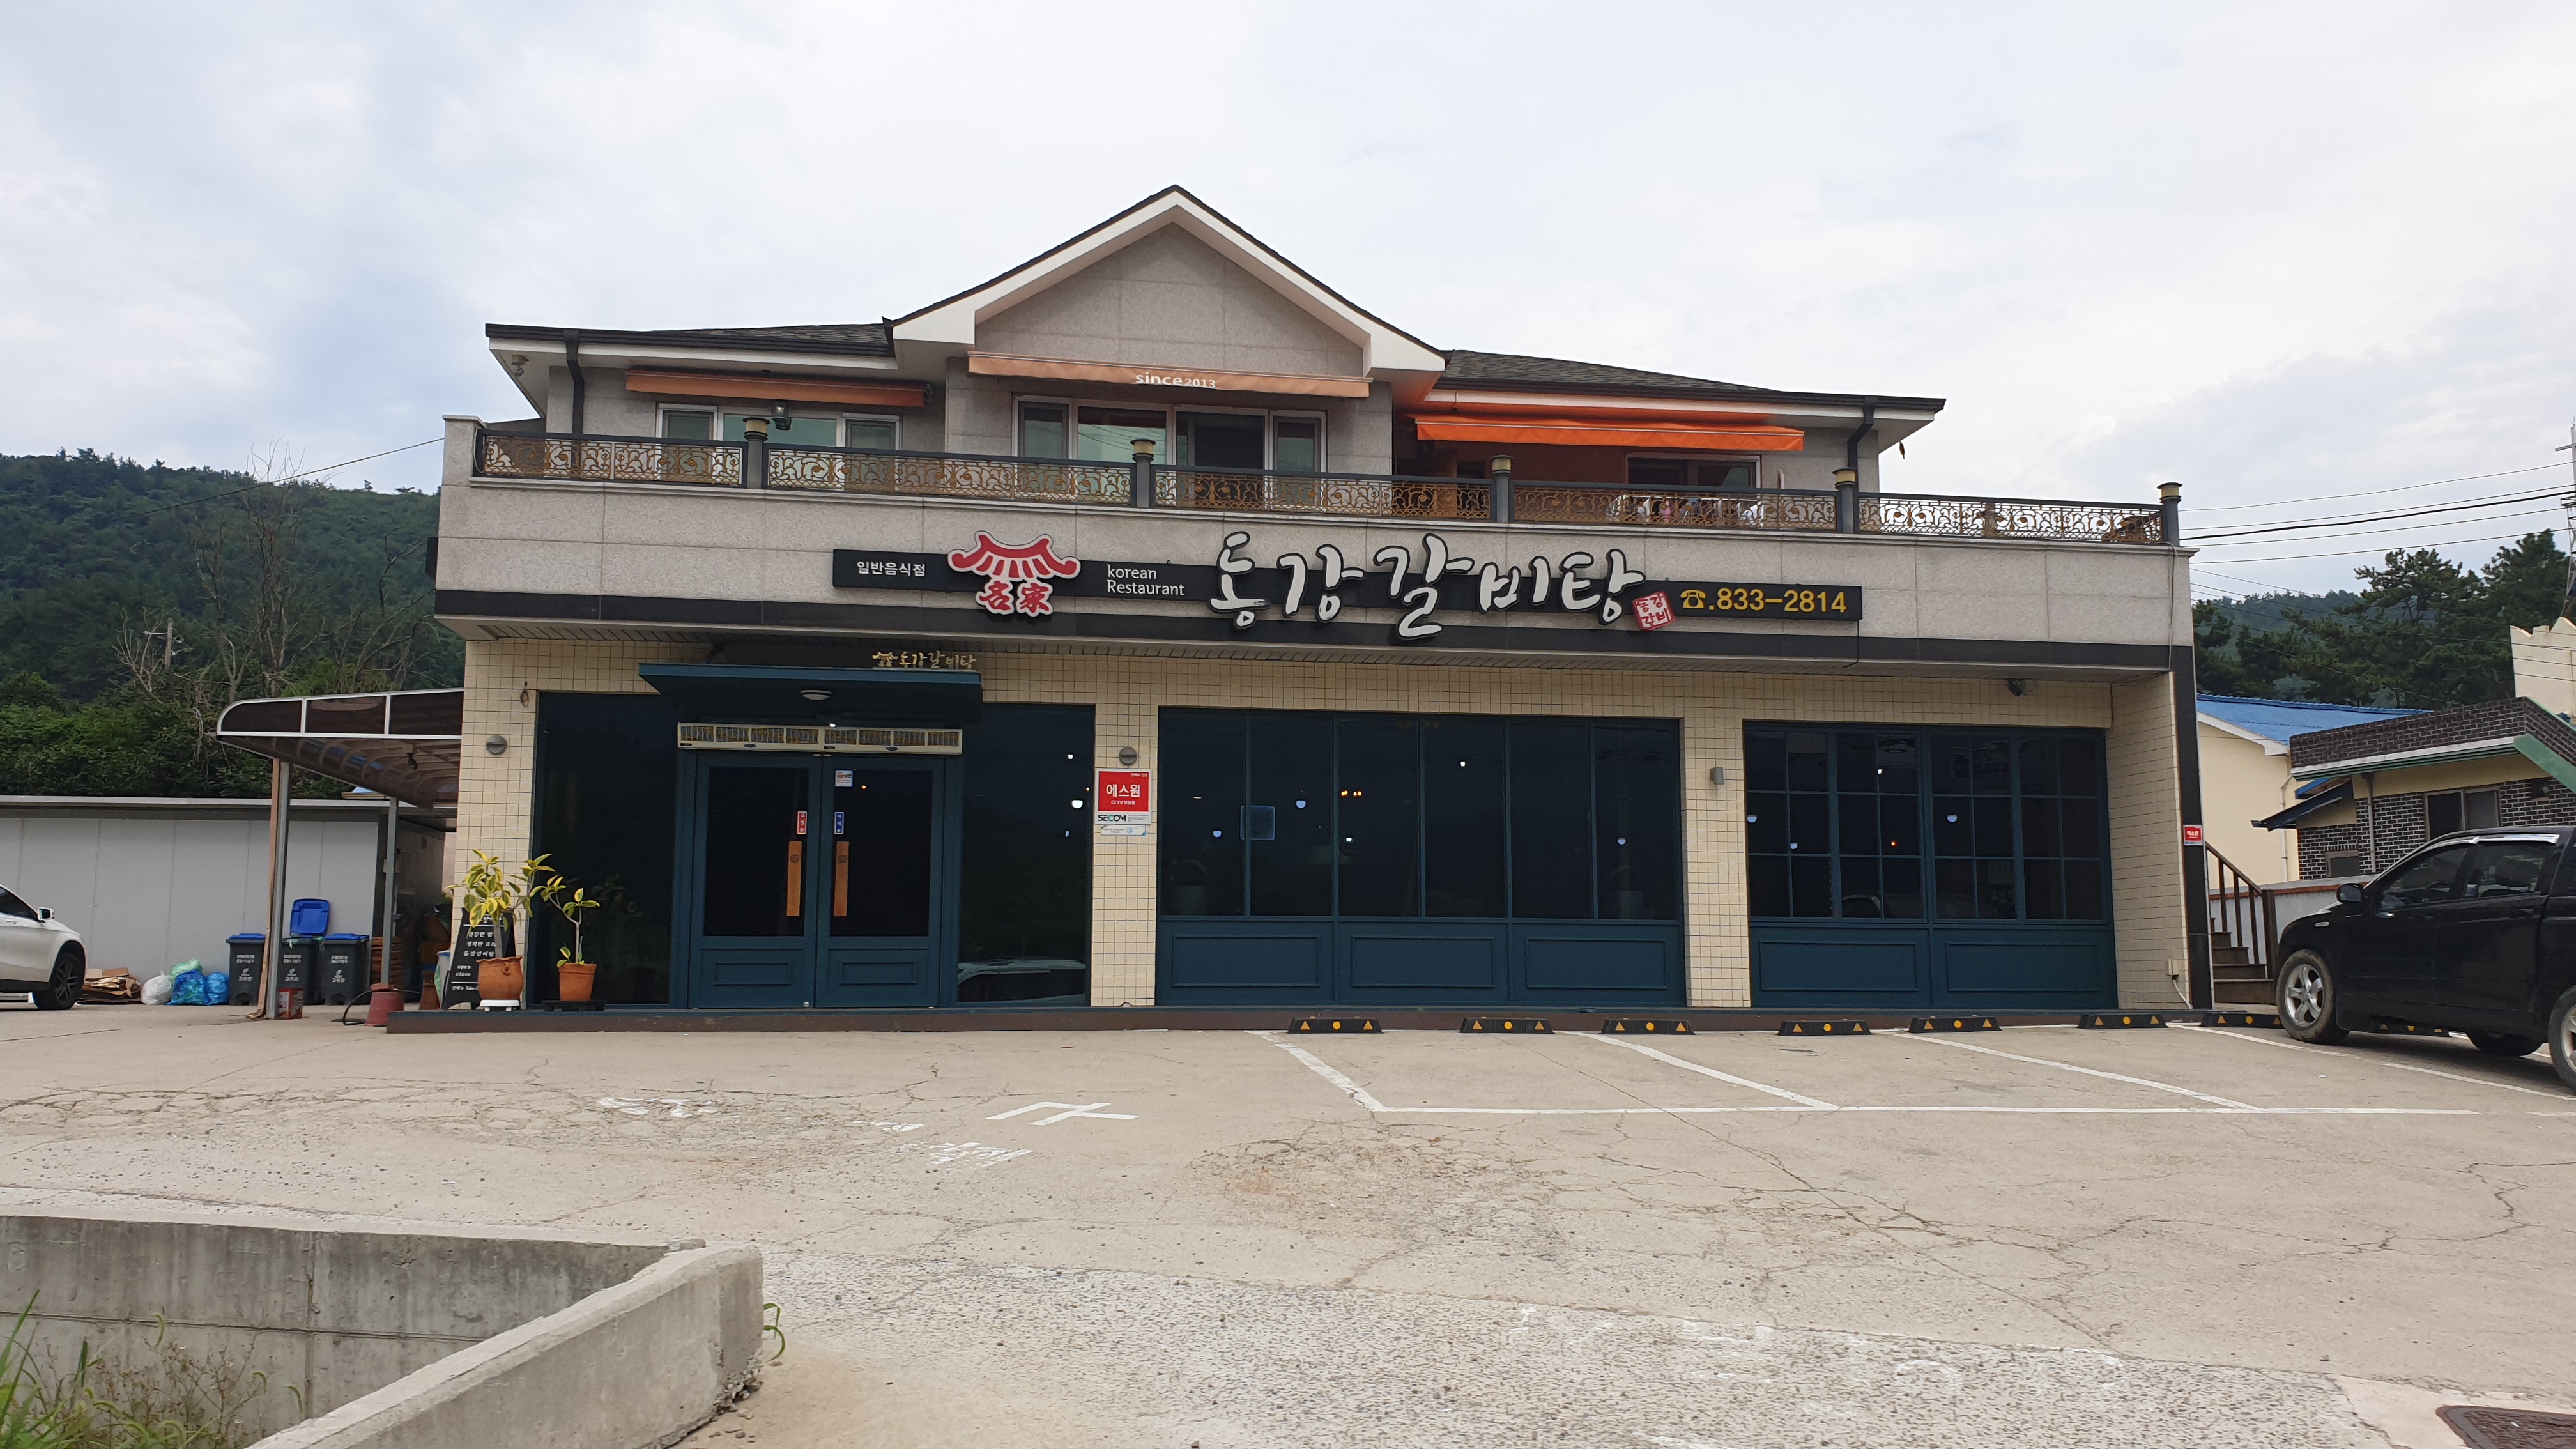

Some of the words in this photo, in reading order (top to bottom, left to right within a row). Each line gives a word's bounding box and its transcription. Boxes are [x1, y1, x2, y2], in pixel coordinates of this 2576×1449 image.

[857, 561, 926, 576] 일반음식점
[1107, 564, 1157, 579] korean
[1107, 579, 1184, 596] Restaurant
[1211, 531, 1646, 639] 동강갈비탕
[1106, 783, 1140, 797] 에스원
